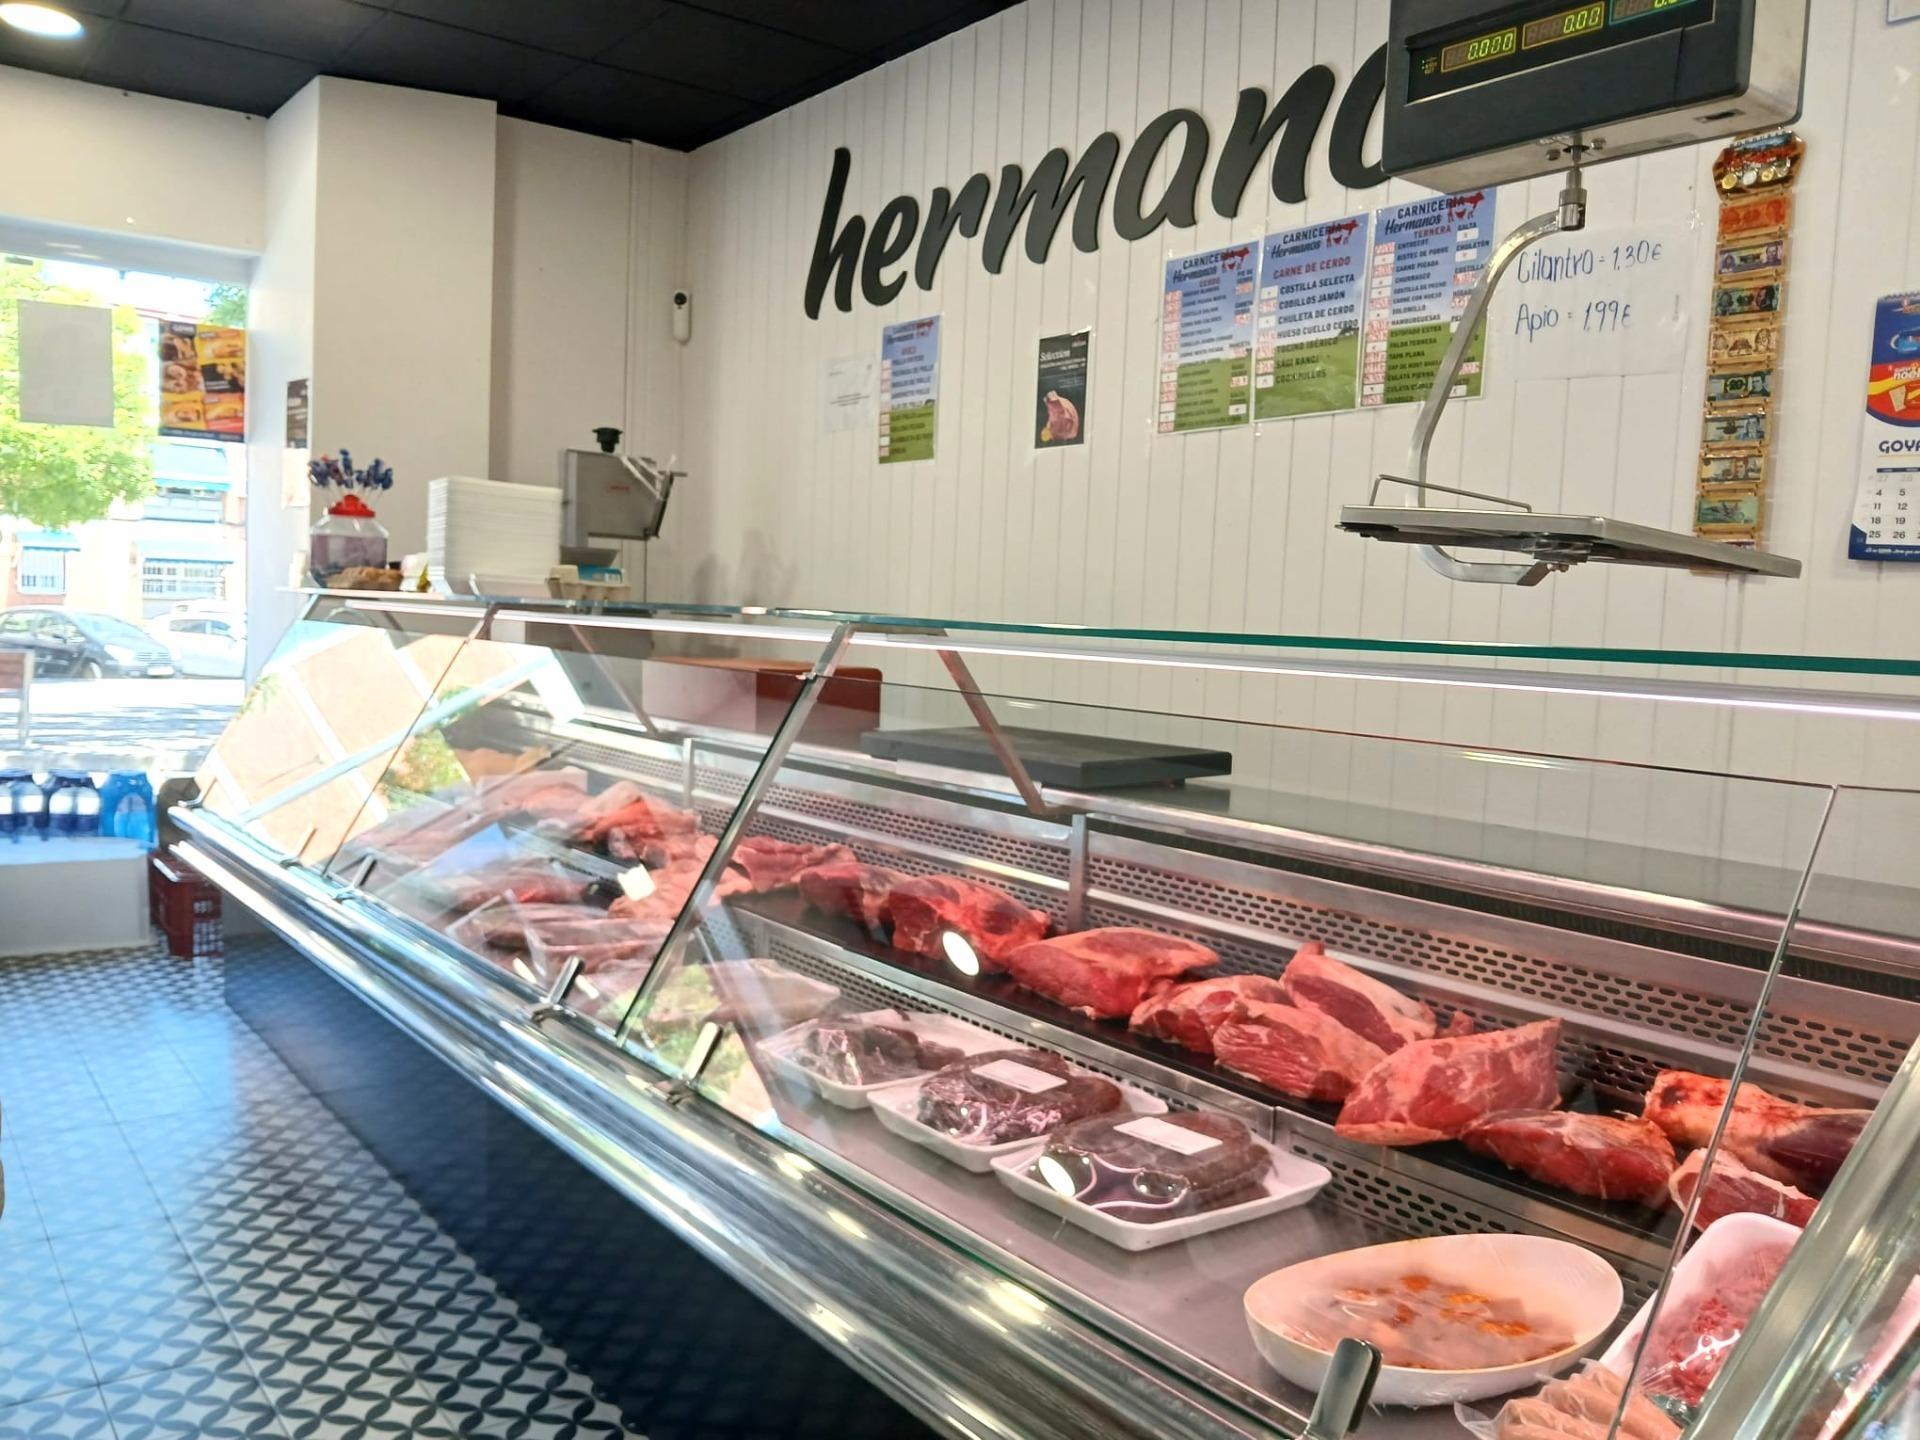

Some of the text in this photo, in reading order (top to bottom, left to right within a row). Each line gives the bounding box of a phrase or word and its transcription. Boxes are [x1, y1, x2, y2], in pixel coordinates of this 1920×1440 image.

[1385, 214, 1442, 236] Hermanos
[1413, 225, 1452, 239] TERNERA
[1271, 239, 1321, 260] Hermanos
[1272, 256, 1351, 280] CARNE DE CERDO
[1280, 273, 1355, 295] COSTILLA SELECTA
[1278, 312, 1313, 325] CHULETA
[1327, 304, 1355, 316] CERDO
[1515, 303, 1559, 343] Apio
[1302, 323, 1331, 335] CUELLO
[1899, 488, 1906, 496] 5
[1871, 516, 1906, 525] 18 19
[1868, 531, 1906, 539] 25 26
